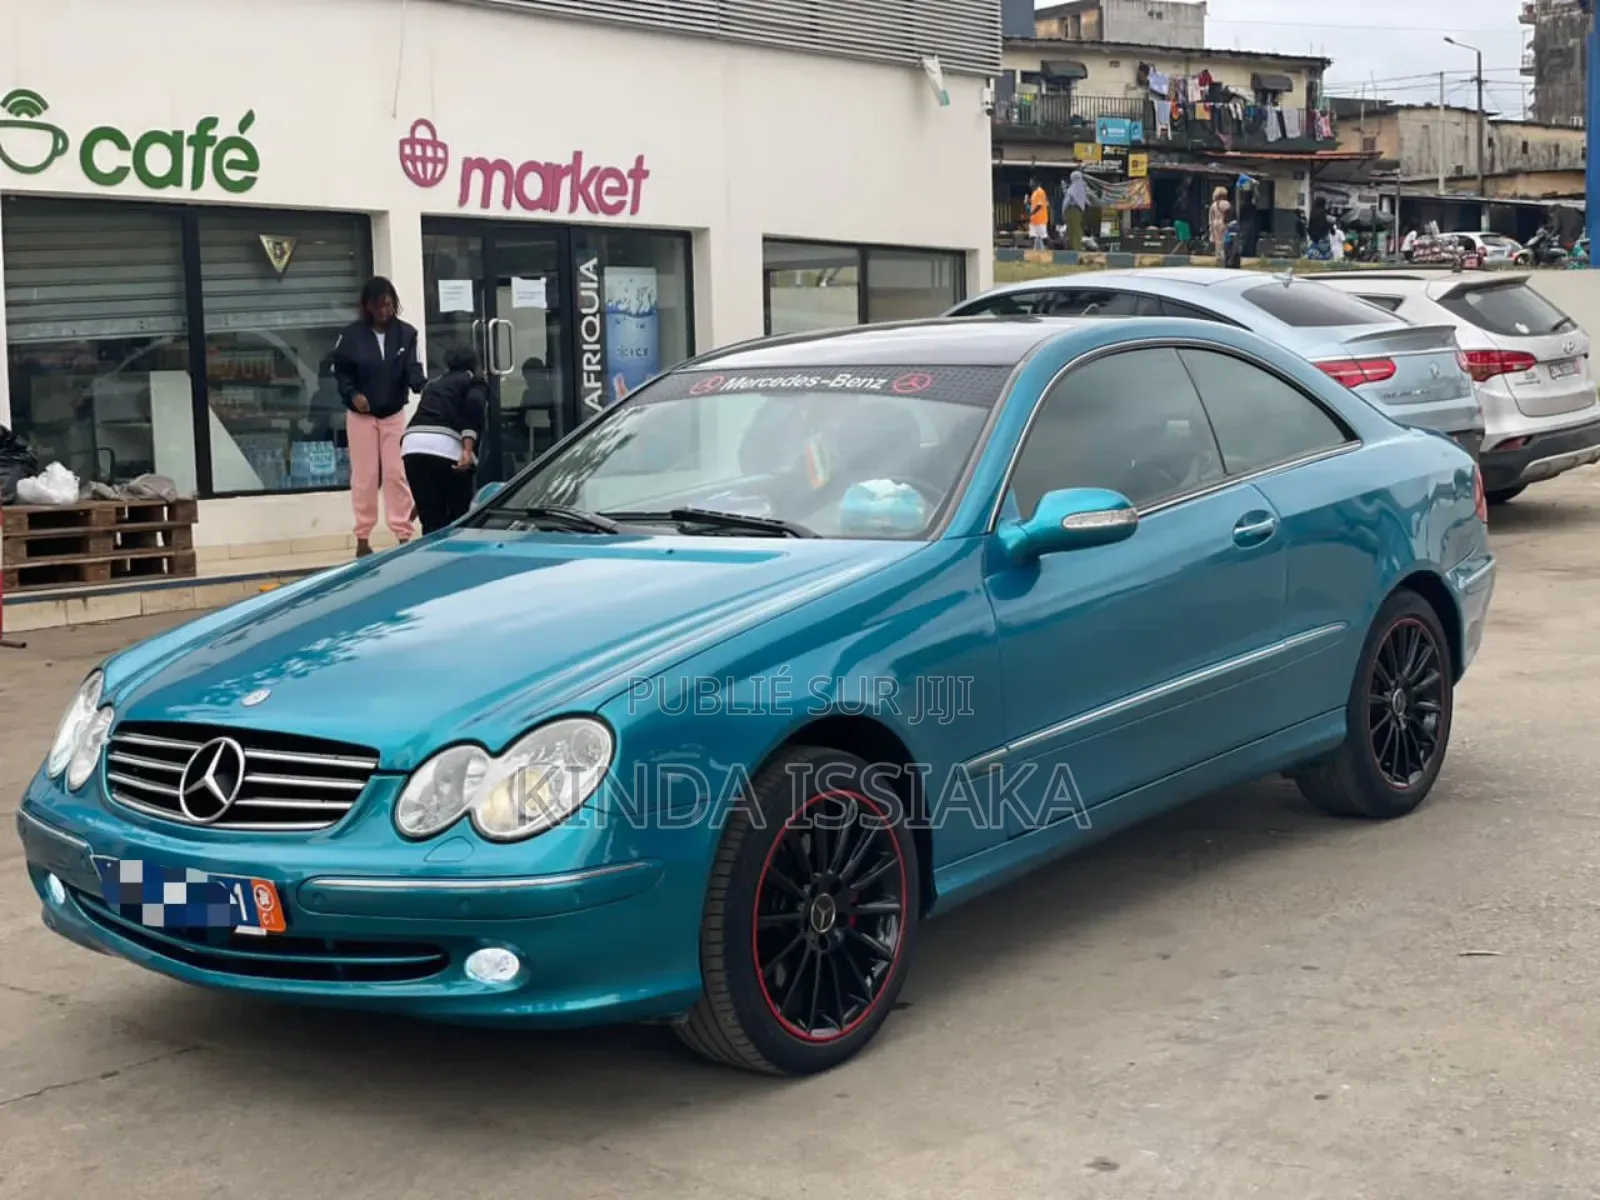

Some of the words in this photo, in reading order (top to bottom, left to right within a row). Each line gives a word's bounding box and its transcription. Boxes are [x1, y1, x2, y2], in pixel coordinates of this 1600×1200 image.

[80, 109, 260, 193] café
[458, 150, 650, 216] market
[579, 256, 602, 415] AFRIQUIA
[721, 374, 887, 391] Mercedes-Benz
